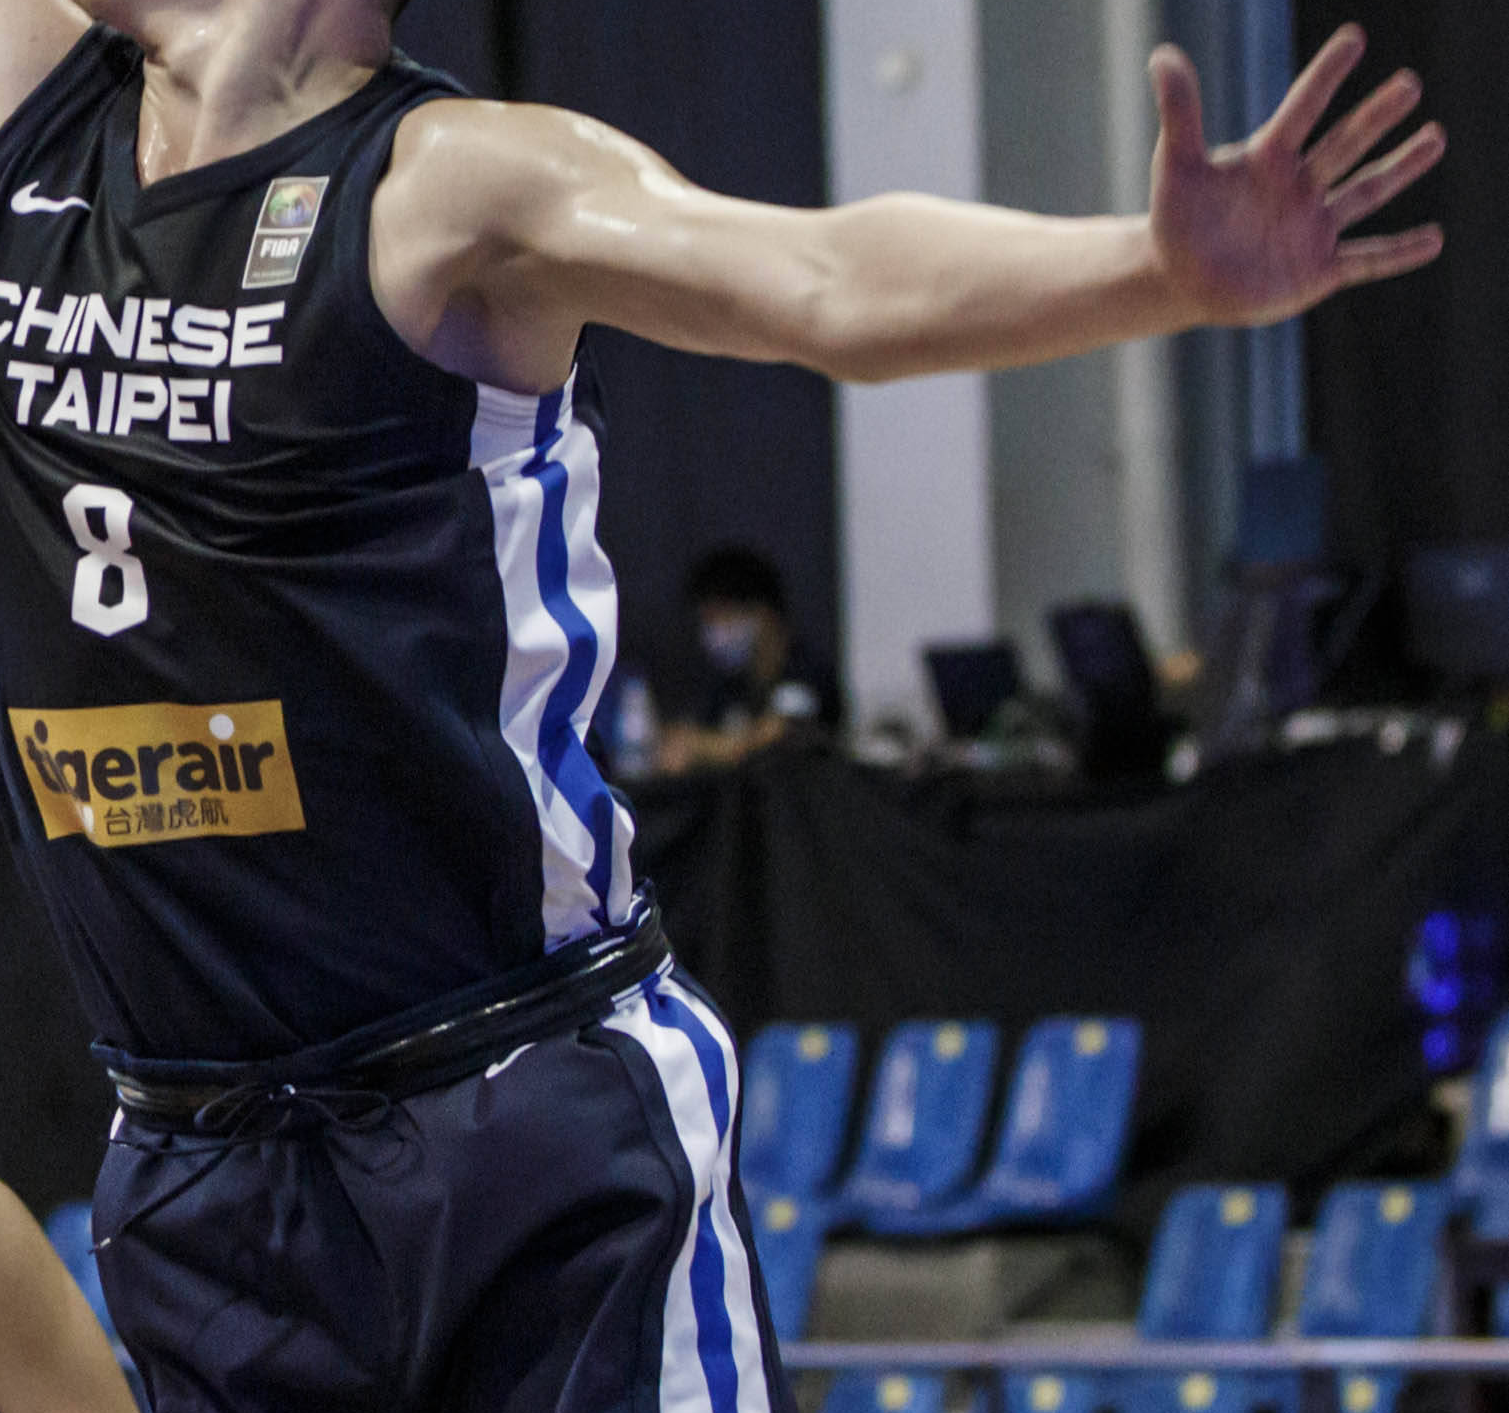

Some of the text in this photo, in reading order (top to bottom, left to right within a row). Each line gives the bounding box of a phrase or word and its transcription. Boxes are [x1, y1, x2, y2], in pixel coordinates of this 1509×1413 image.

[259, 237, 300, 259] FIBA
[6, 360, 232, 442] TAIPEI
[62, 483, 149, 637] 8
